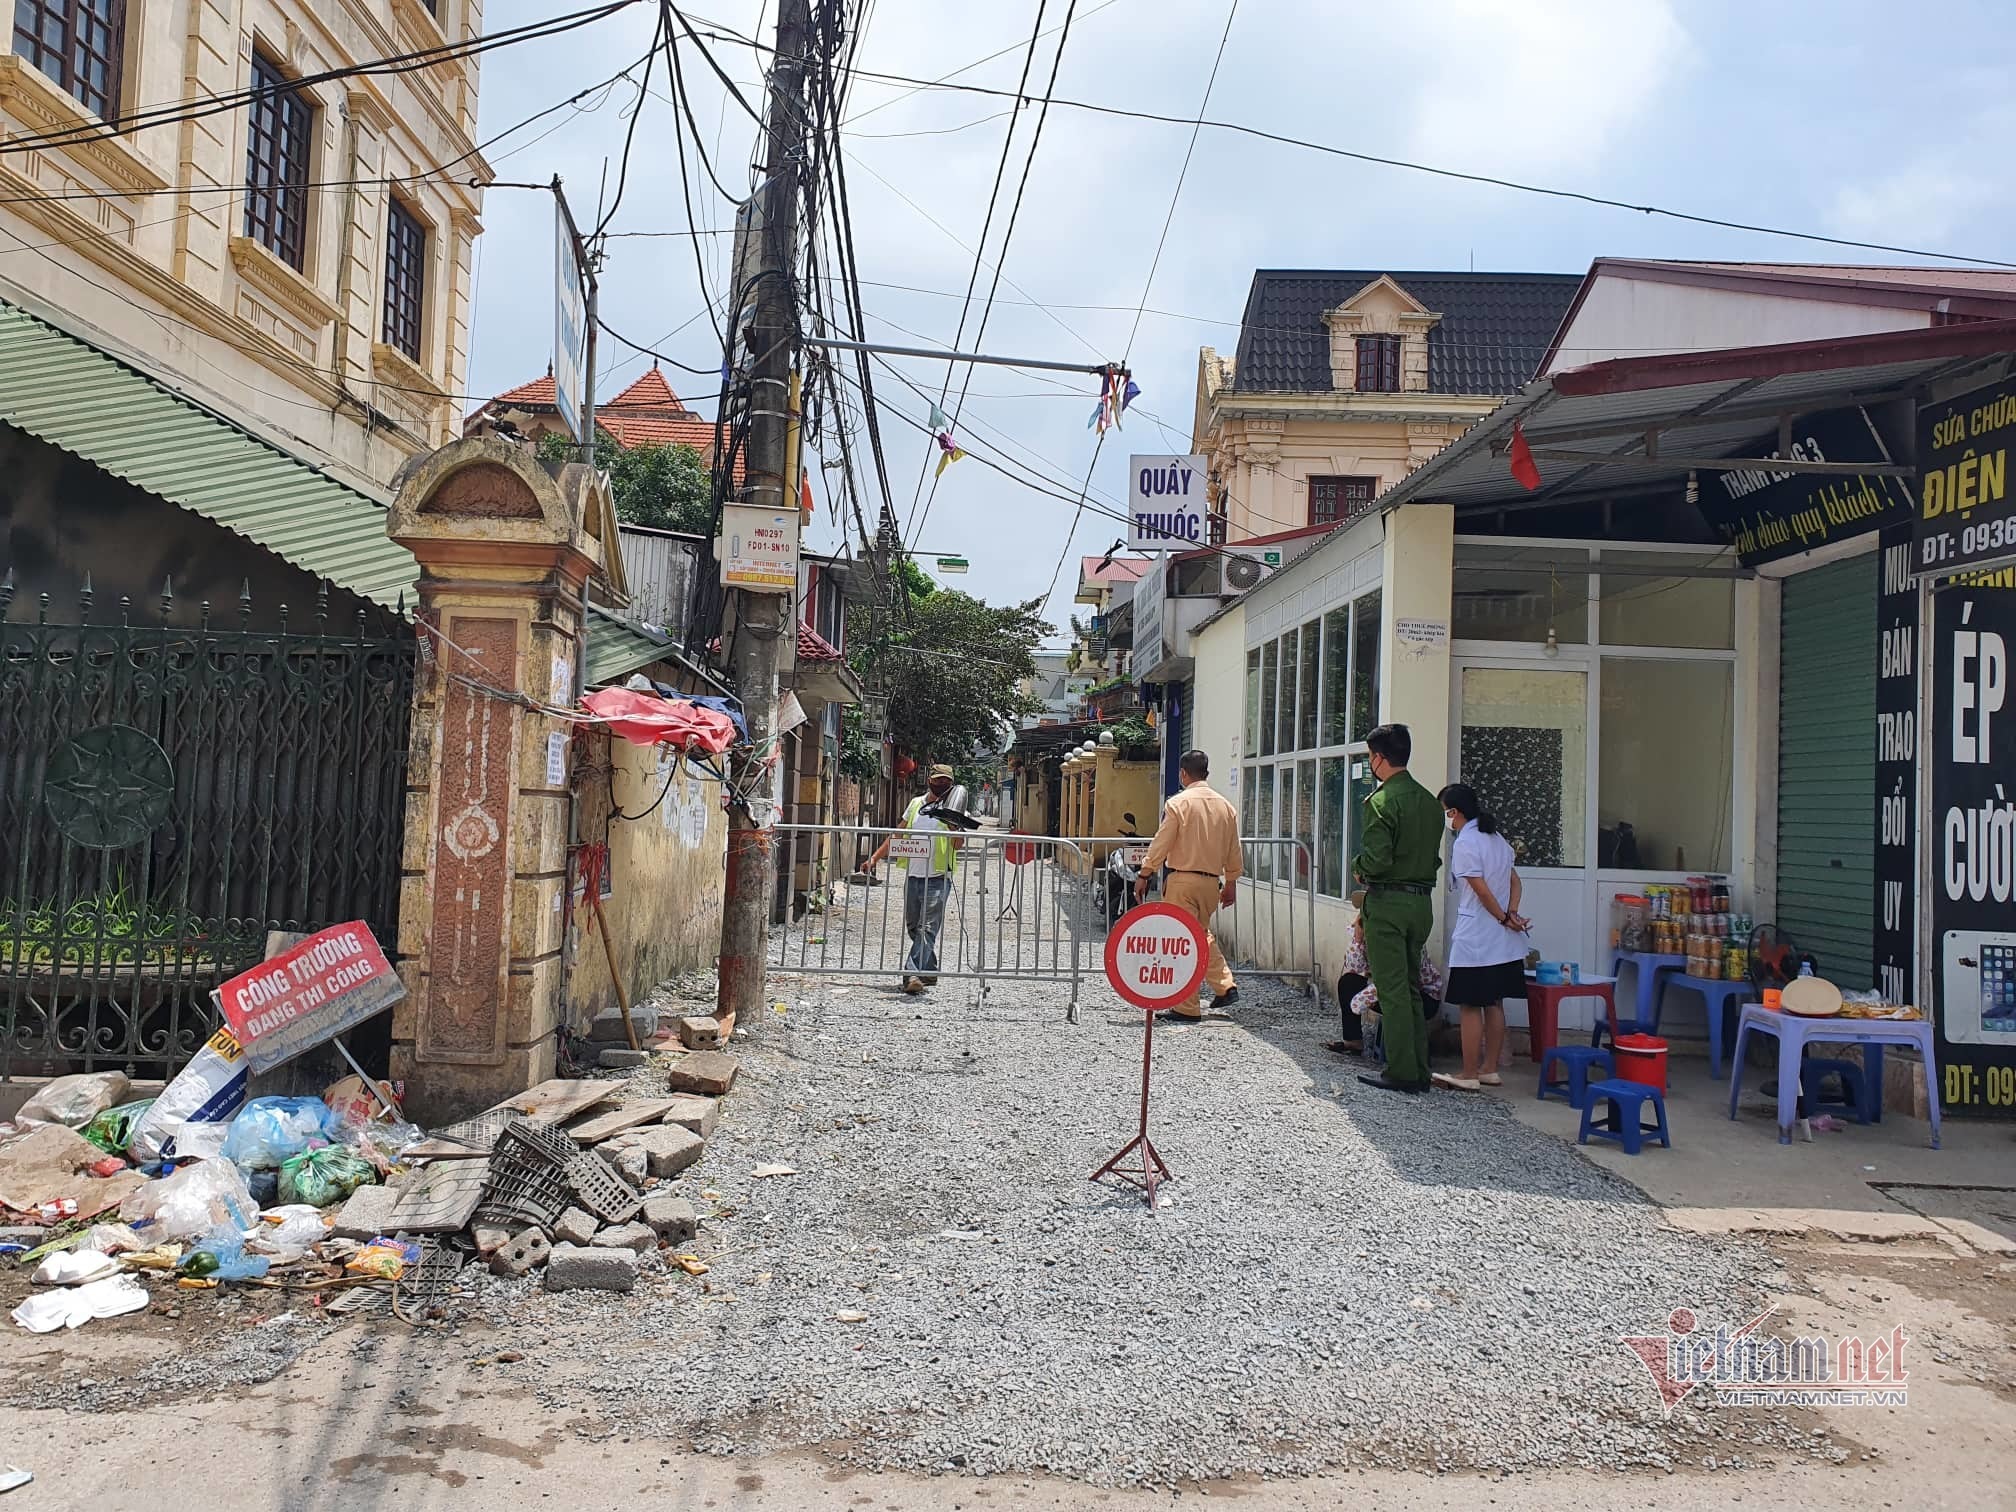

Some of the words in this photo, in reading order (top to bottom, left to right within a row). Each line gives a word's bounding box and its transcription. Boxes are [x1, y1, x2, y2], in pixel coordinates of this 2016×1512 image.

[1932, 408, 1966, 449] SỬA
[1971, 393, 2016, 436] CHỮA
[1139, 459, 1192, 496] QUẦY
[1922, 448, 2005, 520] ĐIỆN
[1135, 504, 1200, 540] THUỐC
[1791, 494, 1828, 544] quý
[1819, 474, 1884, 526] khách
[1884, 542, 1917, 596] MUA
[1922, 533, 1955, 564] ĐT:
[1881, 617, 1912, 679] BÁN
[1952, 601, 2007, 763] ÉP
[1878, 710, 1913, 762] TRAO
[1881, 776, 1906, 847] ĐỔI
[1945, 783, 2016, 903] CƯỜ
[1883, 880, 1903, 931] UY
[235, 969, 291, 1013] CÔNG
[287, 932, 363, 985] TRƯỜNG
[1125, 935, 1157, 955] KHU
[1161, 936, 1191, 960] VỰC
[1139, 960, 1174, 985] CẤM
[246, 1002, 297, 1038] ĐANG
[296, 985, 326, 1012] THI
[327, 958, 374, 993] CÔNG
[1880, 955, 1904, 1004] TÍN
[1945, 1064, 1979, 1105] ĐT:
[1986, 1066, 2016, 1106] 09
